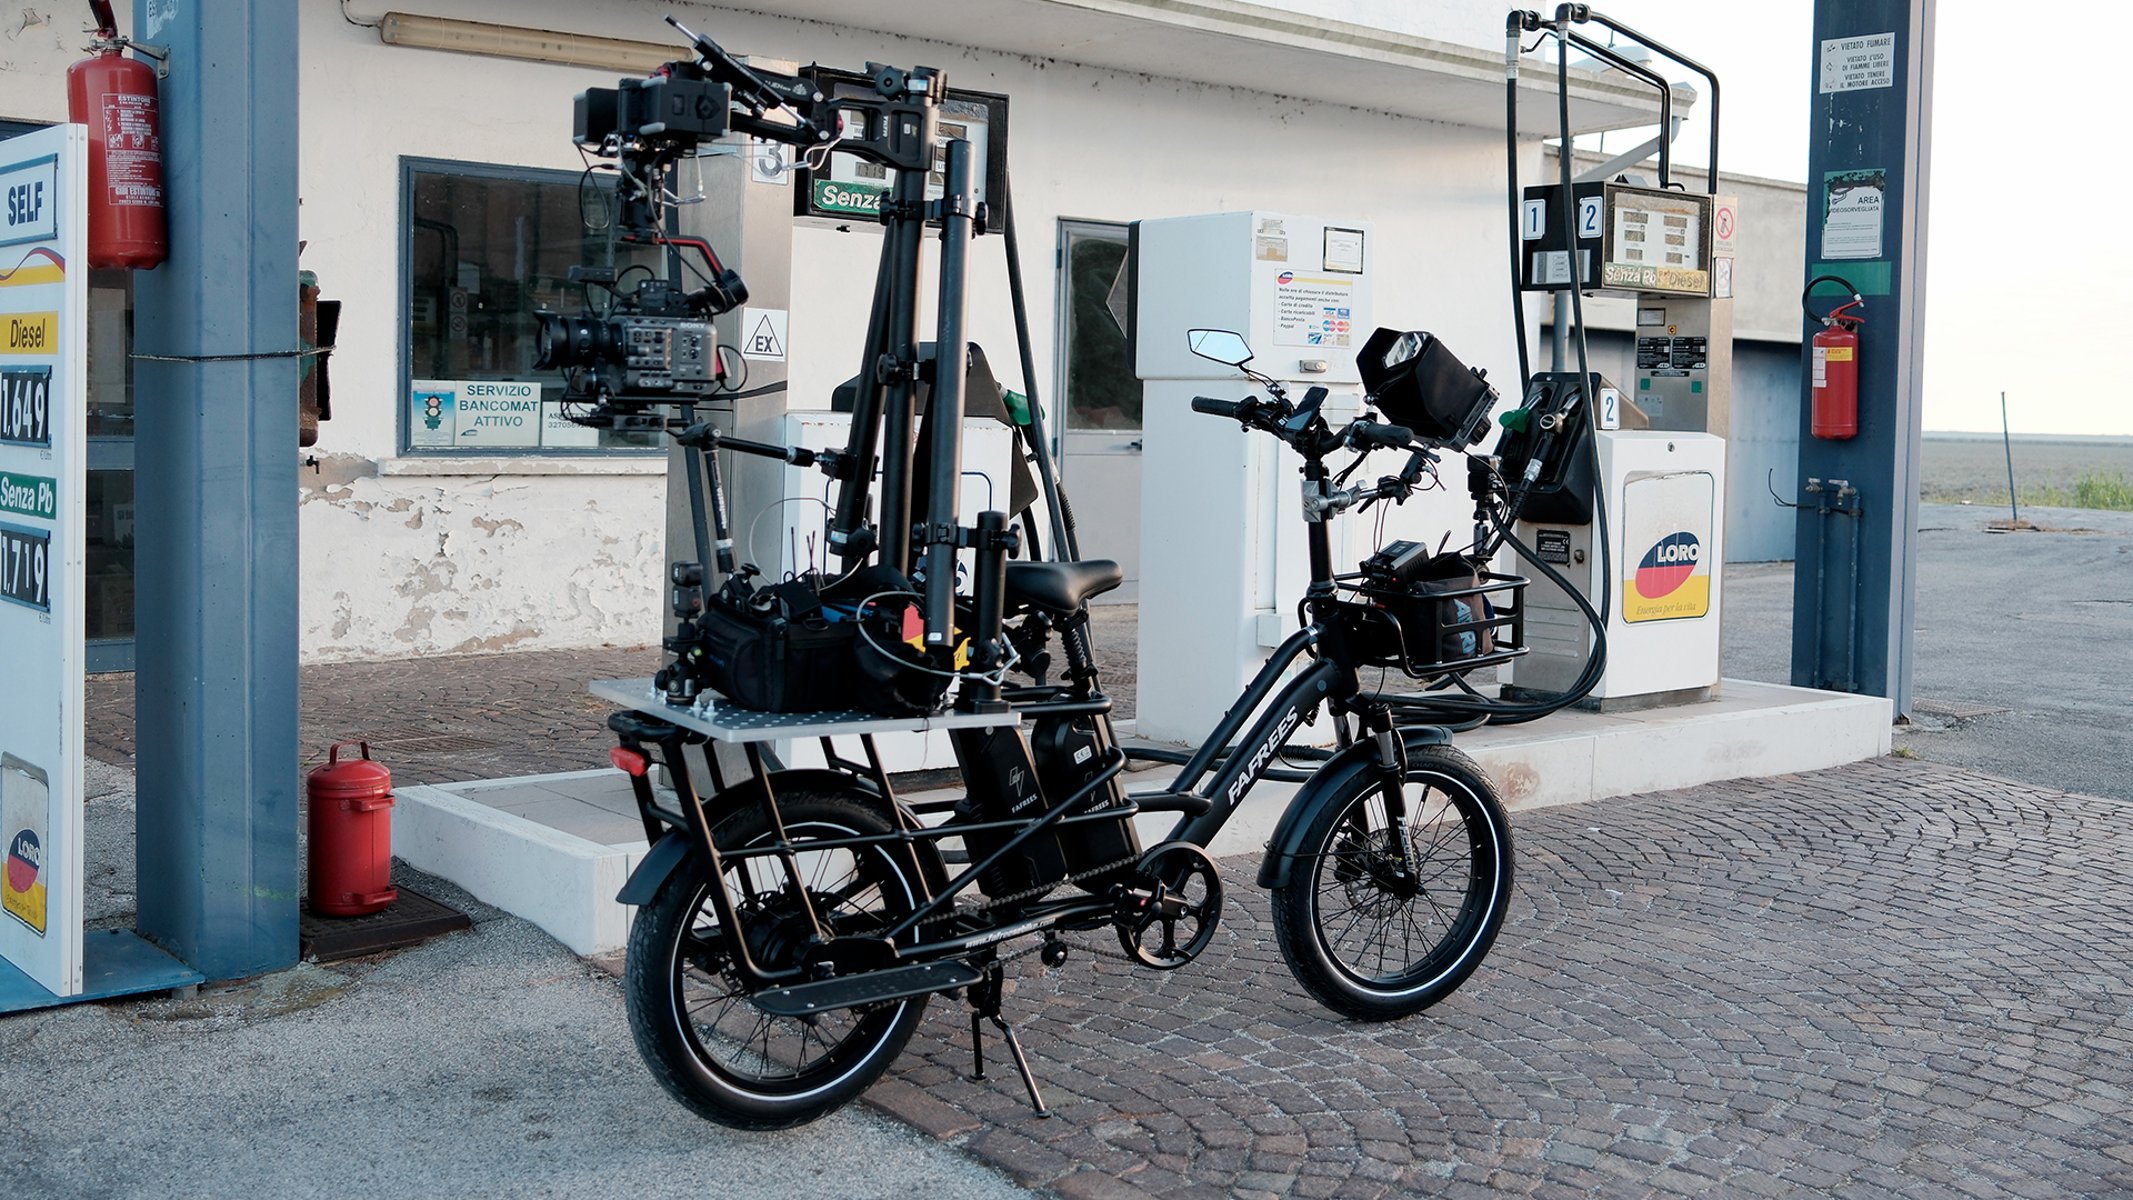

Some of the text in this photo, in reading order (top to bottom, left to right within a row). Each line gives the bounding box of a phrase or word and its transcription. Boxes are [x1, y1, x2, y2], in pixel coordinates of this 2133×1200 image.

[1841, 38, 1891, 50] VIETATO FUMARE
[1851, 62, 1870, 70] FIAMME
[1873, 60, 1889, 68] LIBERE
[1871, 78, 1890, 86] ACCESO
[758, 142, 784, 178] 3
[8, 181, 43, 226] SELF
[1858, 196, 1880, 204] AREA
[1531, 207, 1537, 232] 1
[1585, 204, 1596, 231] 2
[1605, 265, 1657, 285] Senza Pb
[1669, 271, 1704, 289] Diesel
[10, 318, 46, 348] Diesel
[755, 335, 773, 353] EX
[467, 384, 531, 397] SERVIZIO
[2, 377, 45, 439] 1,649
[459, 400, 539, 412] BANCOMAT
[1606, 396, 1614, 422] 2
[474, 416, 523, 427] ATTIVO
[1, 476, 53, 514] Senza Pb
[1657, 543, 1700, 563] LORO
[1, 536, 43, 603] 1,719
[1636, 602, 1697, 616] Energia per la vita
[1227, 705, 1299, 806] FAFREES
[1011, 793, 1038, 814] FAFREES
[18, 837, 40, 866] LORO
